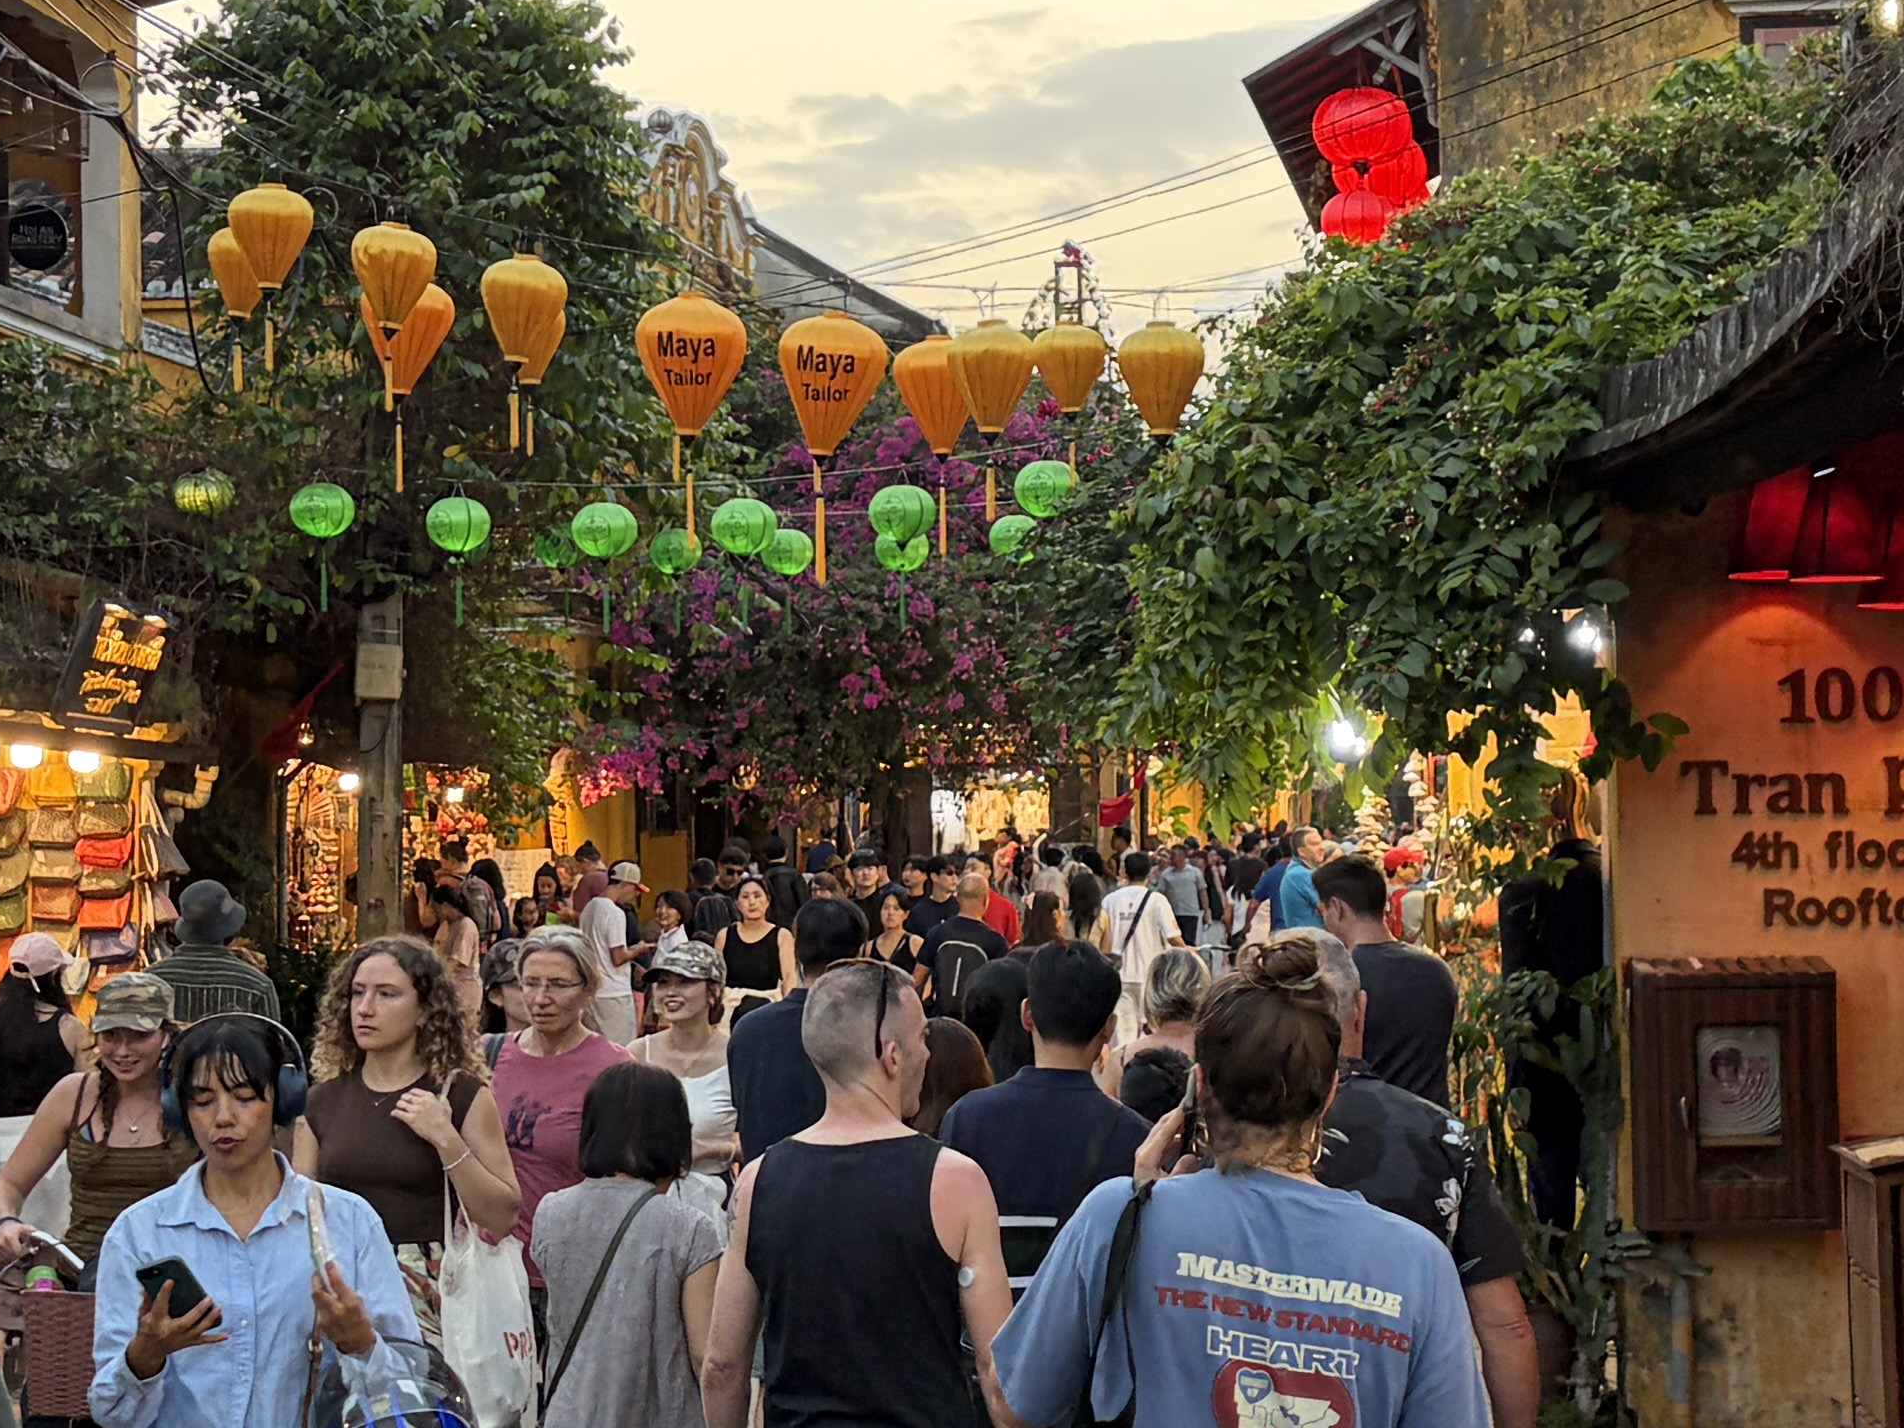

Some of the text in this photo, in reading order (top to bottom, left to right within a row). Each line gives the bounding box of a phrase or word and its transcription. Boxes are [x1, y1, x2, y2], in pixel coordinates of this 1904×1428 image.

[657, 330, 716, 364] Maya
[797, 345, 856, 380] Maya
[664, 368, 713, 387] Tailor
[801, 383, 851, 402] Tailor
[1777, 666, 1904, 724] 100
[1680, 760, 1850, 816] Tran
[1732, 831, 1799, 870] 4th
[1176, 1252, 1403, 1317] MASTERMADE
[1154, 1285, 1412, 1354] THE NEW STANDARD
[1206, 1325, 1360, 1379] HEART
